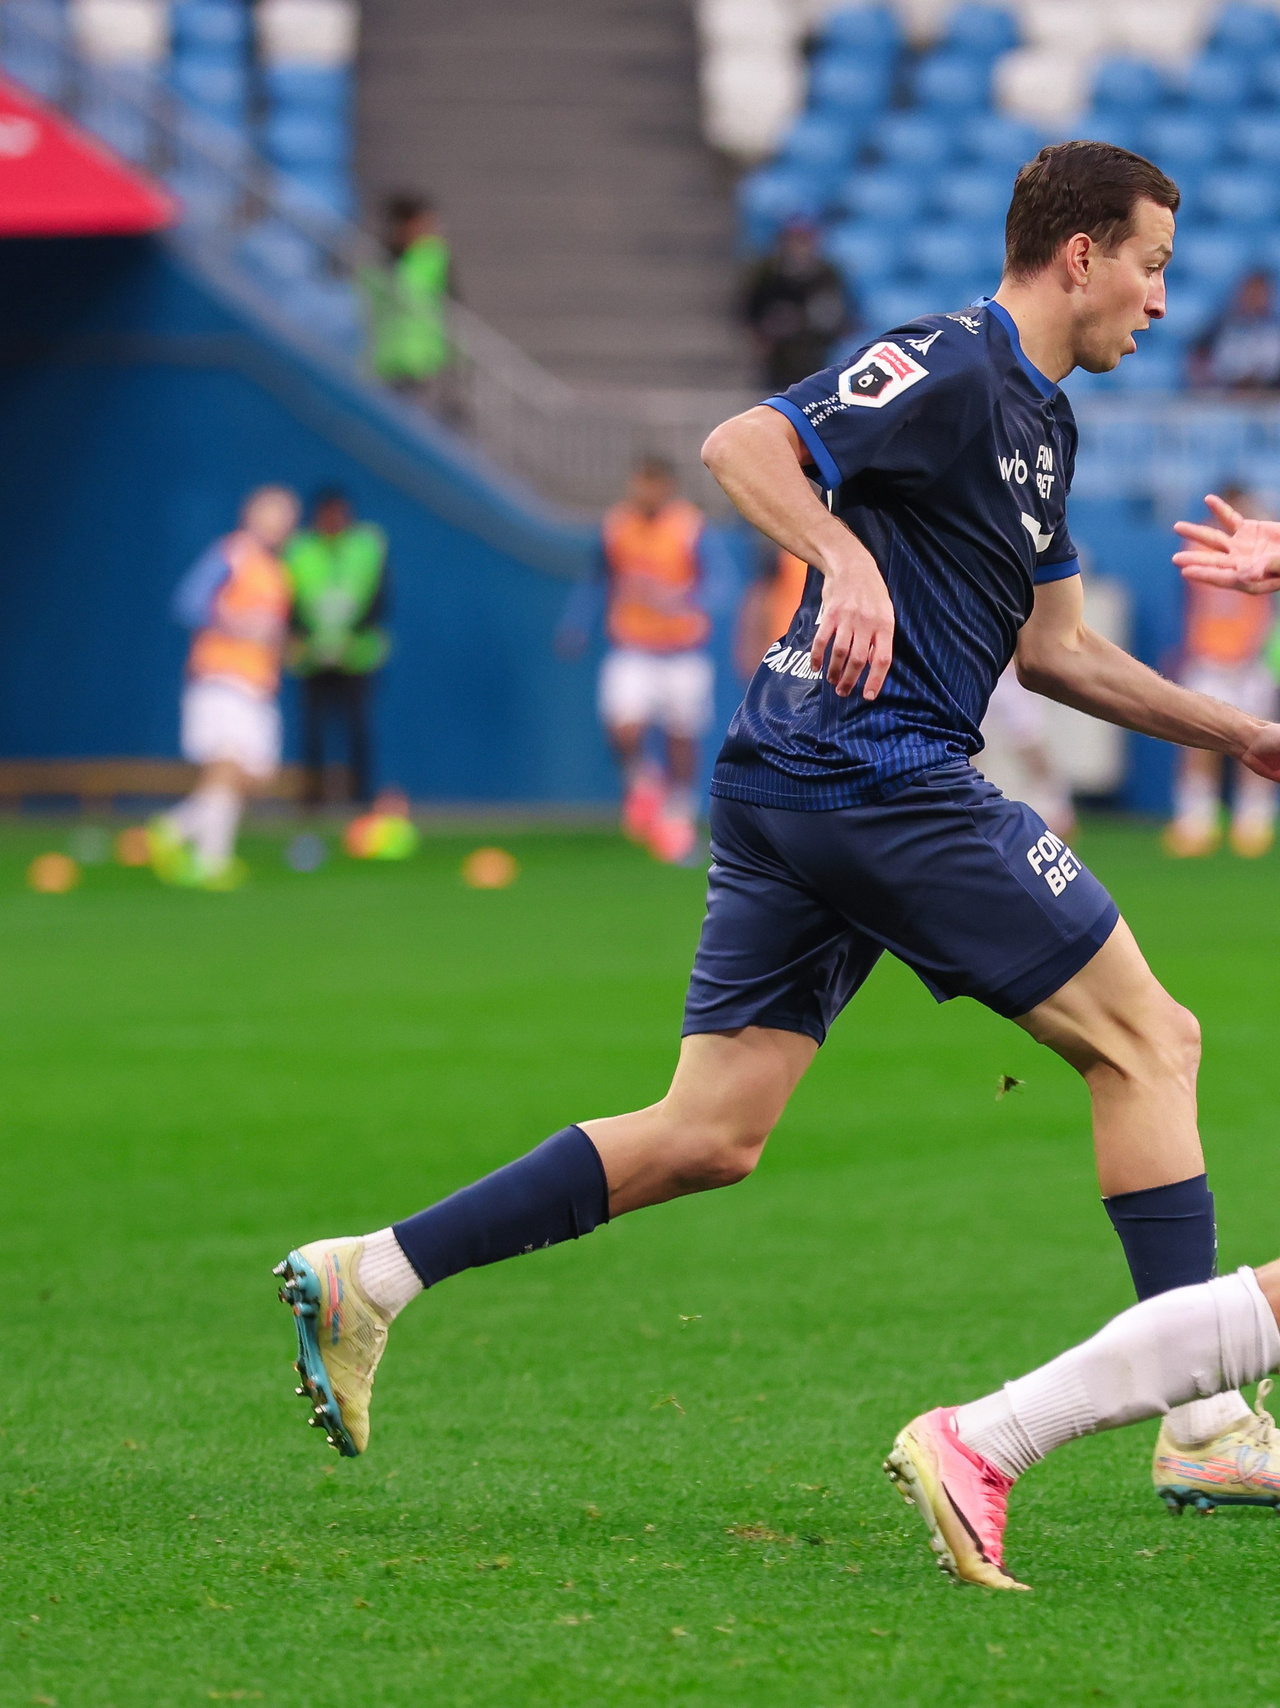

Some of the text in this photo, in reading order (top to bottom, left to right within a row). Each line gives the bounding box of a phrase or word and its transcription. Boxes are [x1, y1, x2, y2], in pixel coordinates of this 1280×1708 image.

[997, 448, 1028, 485] wb
[1026, 829, 1065, 876] FON
[1043, 846, 1082, 898] BET
